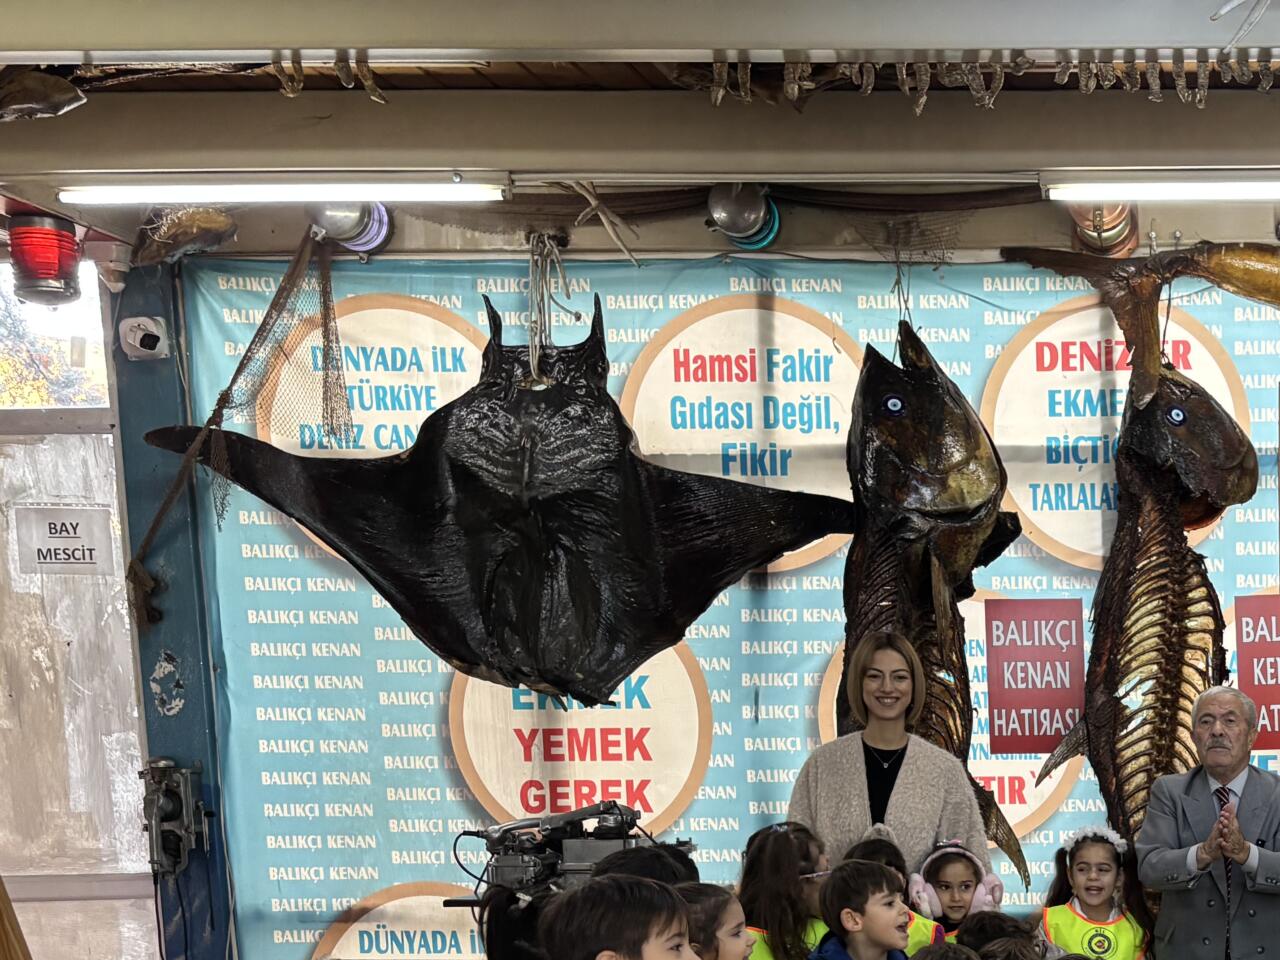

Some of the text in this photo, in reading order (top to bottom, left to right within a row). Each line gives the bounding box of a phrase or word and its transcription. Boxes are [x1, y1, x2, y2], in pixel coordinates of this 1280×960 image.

[729, 277, 842, 296] BALIKÇI KENAN
[983, 276, 1040, 295] BALIKÇI
[606, 295, 664, 312] BALIKÇI
[920, 295, 969, 309] KENAN
[920, 328, 970, 342] KENAN
[673, 347, 834, 383] Hamsi Fakir
[1048, 389, 1123, 417] EKME
[669, 395, 840, 434] Gıdası Değil,
[721, 442, 793, 476] Fikir
[48, 522, 79, 536] BAY
[37, 545, 96, 561] MESCİT
[241, 544, 299, 561] BALIKÇI
[244, 577, 356, 594] BALIKÇI KENAN
[991, 575, 1048, 592] BALIKÇI
[247, 610, 359, 627] BALIKÇI KENAN
[741, 608, 797, 625] BALIKÇI
[992, 619, 1077, 652] BALIKÇI
[250, 642, 361, 660] BALIKÇI KENAN
[741, 640, 797, 658] BALIKÇI
[376, 659, 432, 676] BALIKÇI
[1003, 661, 1070, 689] KENAN
[253, 675, 364, 692] BALIKÇI KENAN
[741, 673, 797, 690] BALIKÇI
[379, 691, 434, 708] BALIKÇI
[256, 707, 366, 724] BALIKÇI KENAN
[742, 705, 798, 722] BALIKÇI
[381, 724, 437, 740] BALIKÇI
[258, 739, 369, 756] BALIKÇI KENAN
[513, 727, 653, 763] YEMEK
[744, 737, 800, 754] BALIKÇI
[384, 755, 439, 772] BALIKÇI
[261, 771, 371, 788] BALIKÇI KENAN
[386, 787, 441, 804] BALIKÇI
[520, 779, 654, 814] GEREK
[264, 803, 374, 820] BALIKÇI KENAN
[389, 819, 443, 835] BALIKÇI
[690, 818, 739, 832] KENAN
[266, 835, 376, 852] BALIKÇI KENAN
[391, 851, 445, 867] BALIKÇI
[268, 867, 379, 884] BALIKÇI KENAN
[271, 898, 327, 915] BALIKÇI
[359, 924, 462, 955] DÜNYADA
